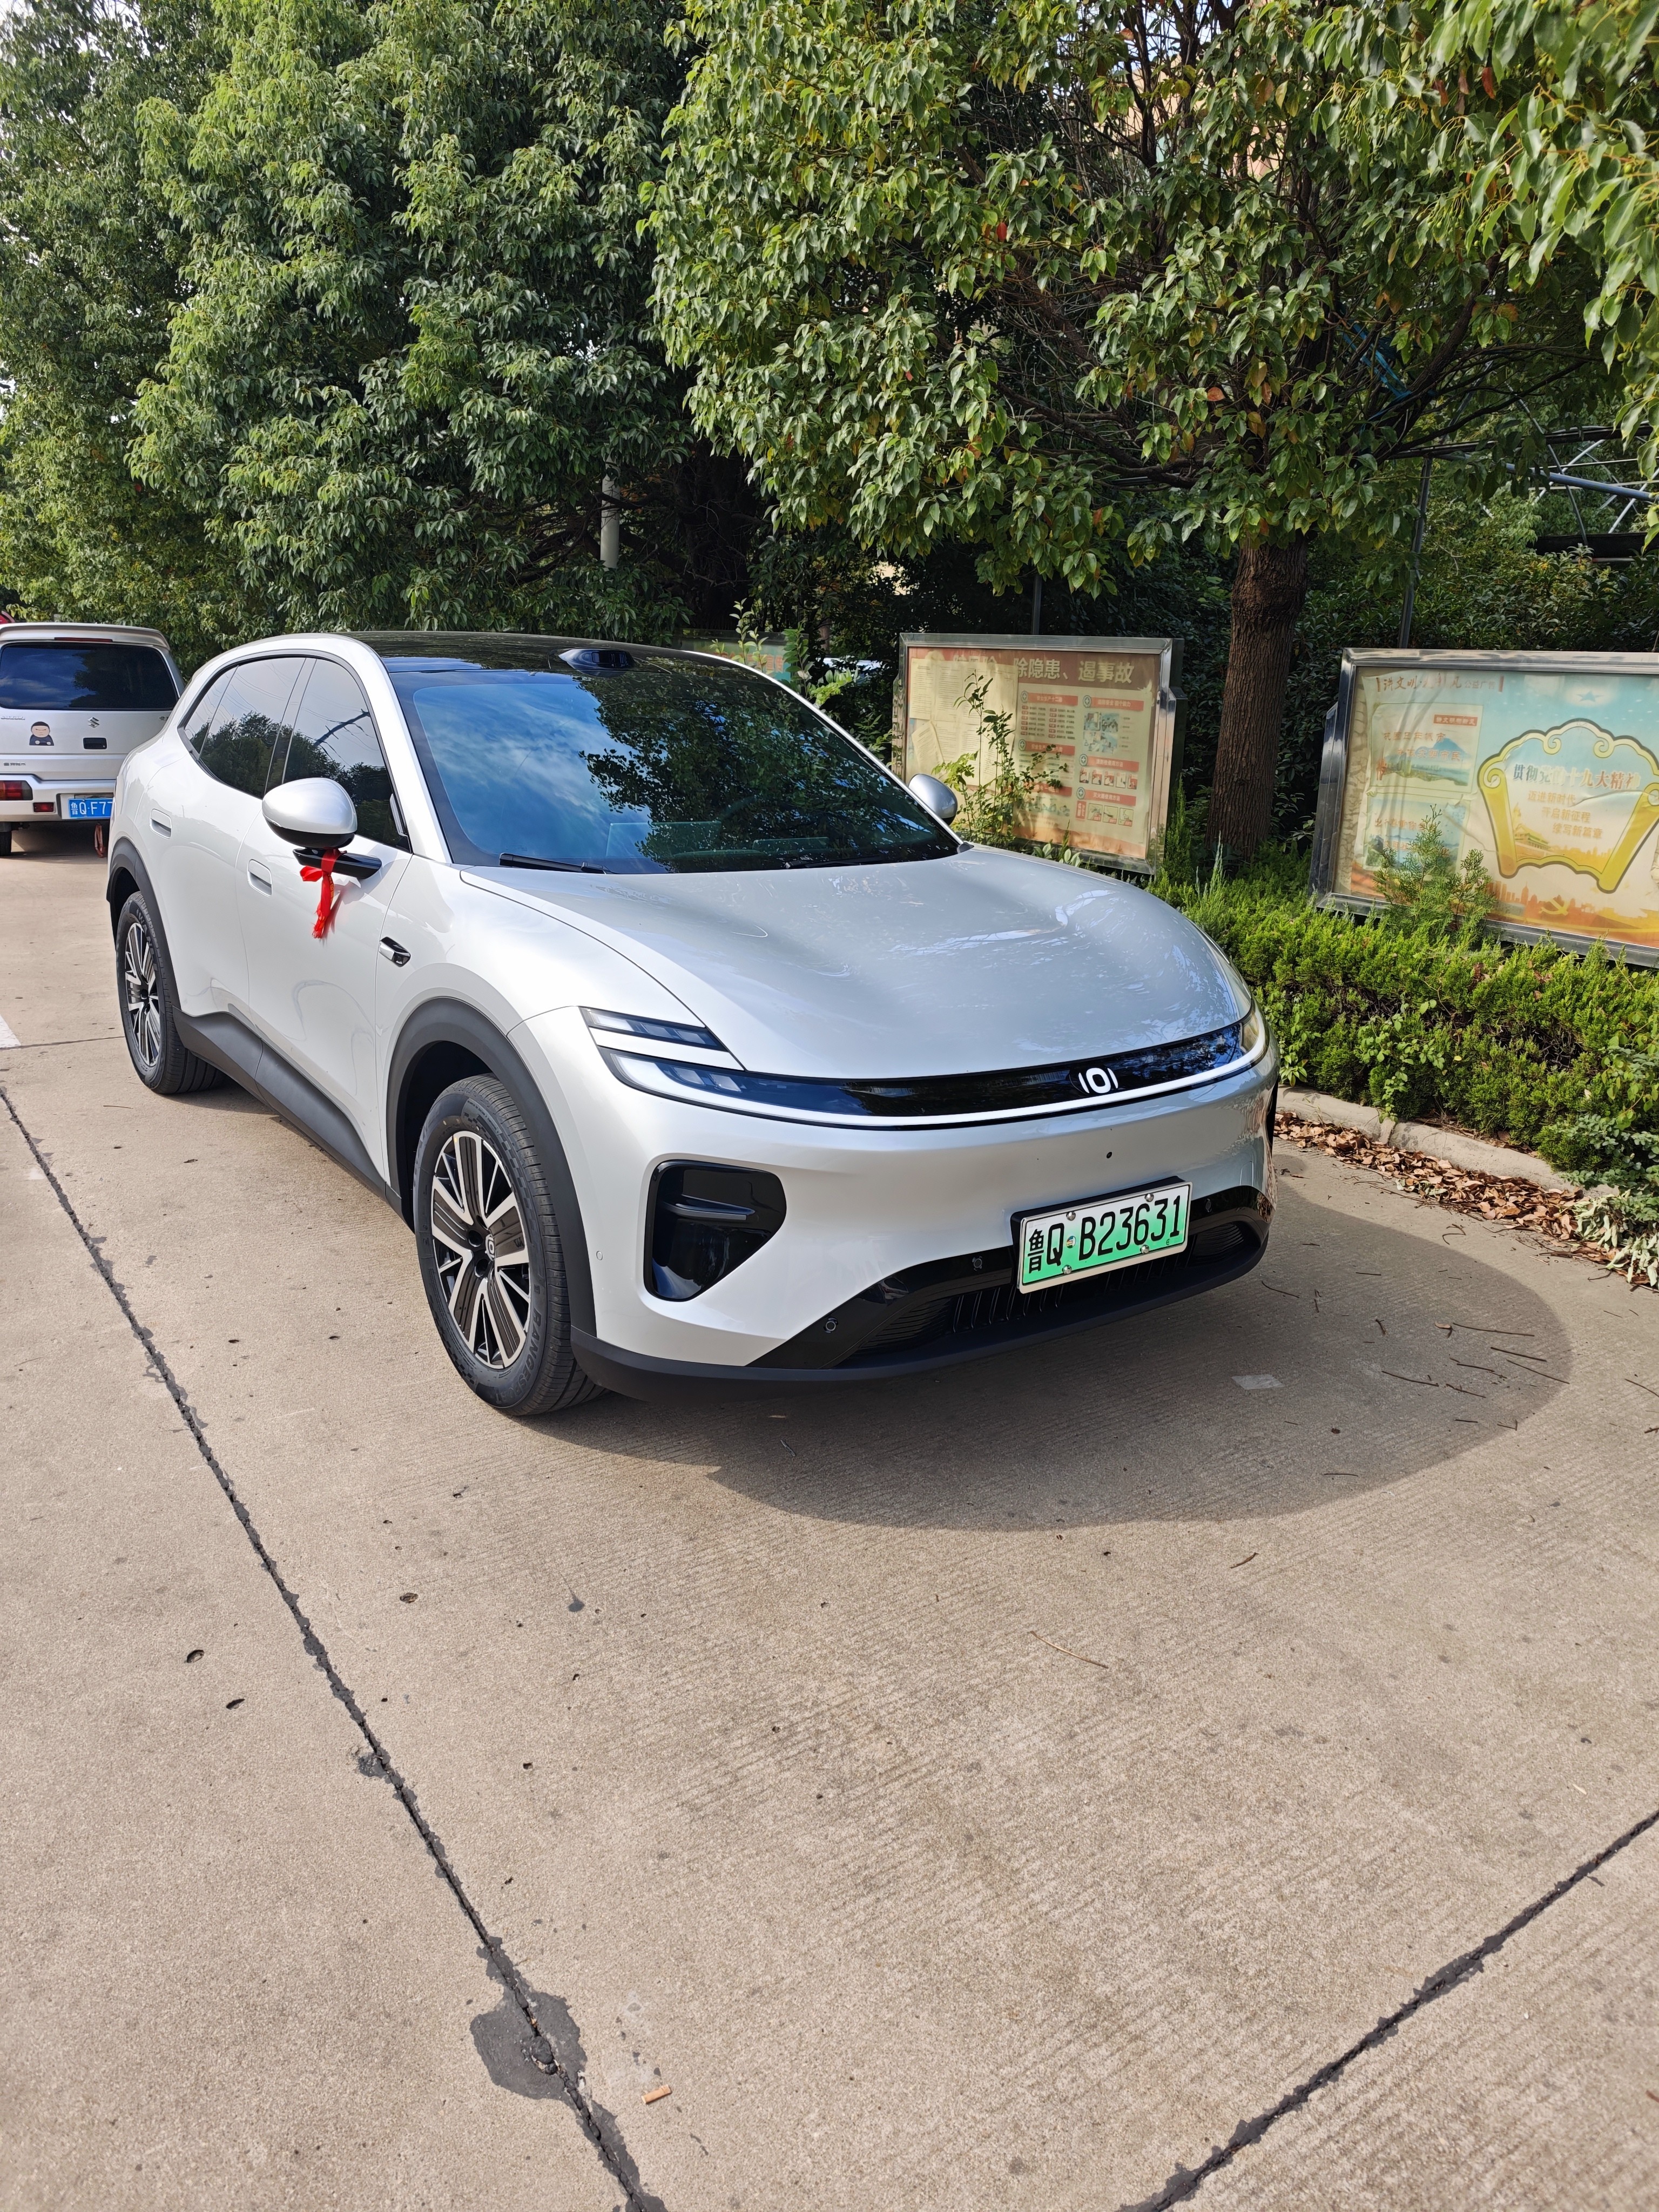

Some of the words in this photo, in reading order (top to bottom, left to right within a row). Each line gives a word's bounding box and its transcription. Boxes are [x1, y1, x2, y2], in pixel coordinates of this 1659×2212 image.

[1513, 763, 1641, 790] 贯彻党的十九大精神
[1528, 790, 1576, 805] 迈进新时代
[1542, 806, 1591, 824] 开启新征程
[1552, 822, 1603, 839] 续写新篇章
